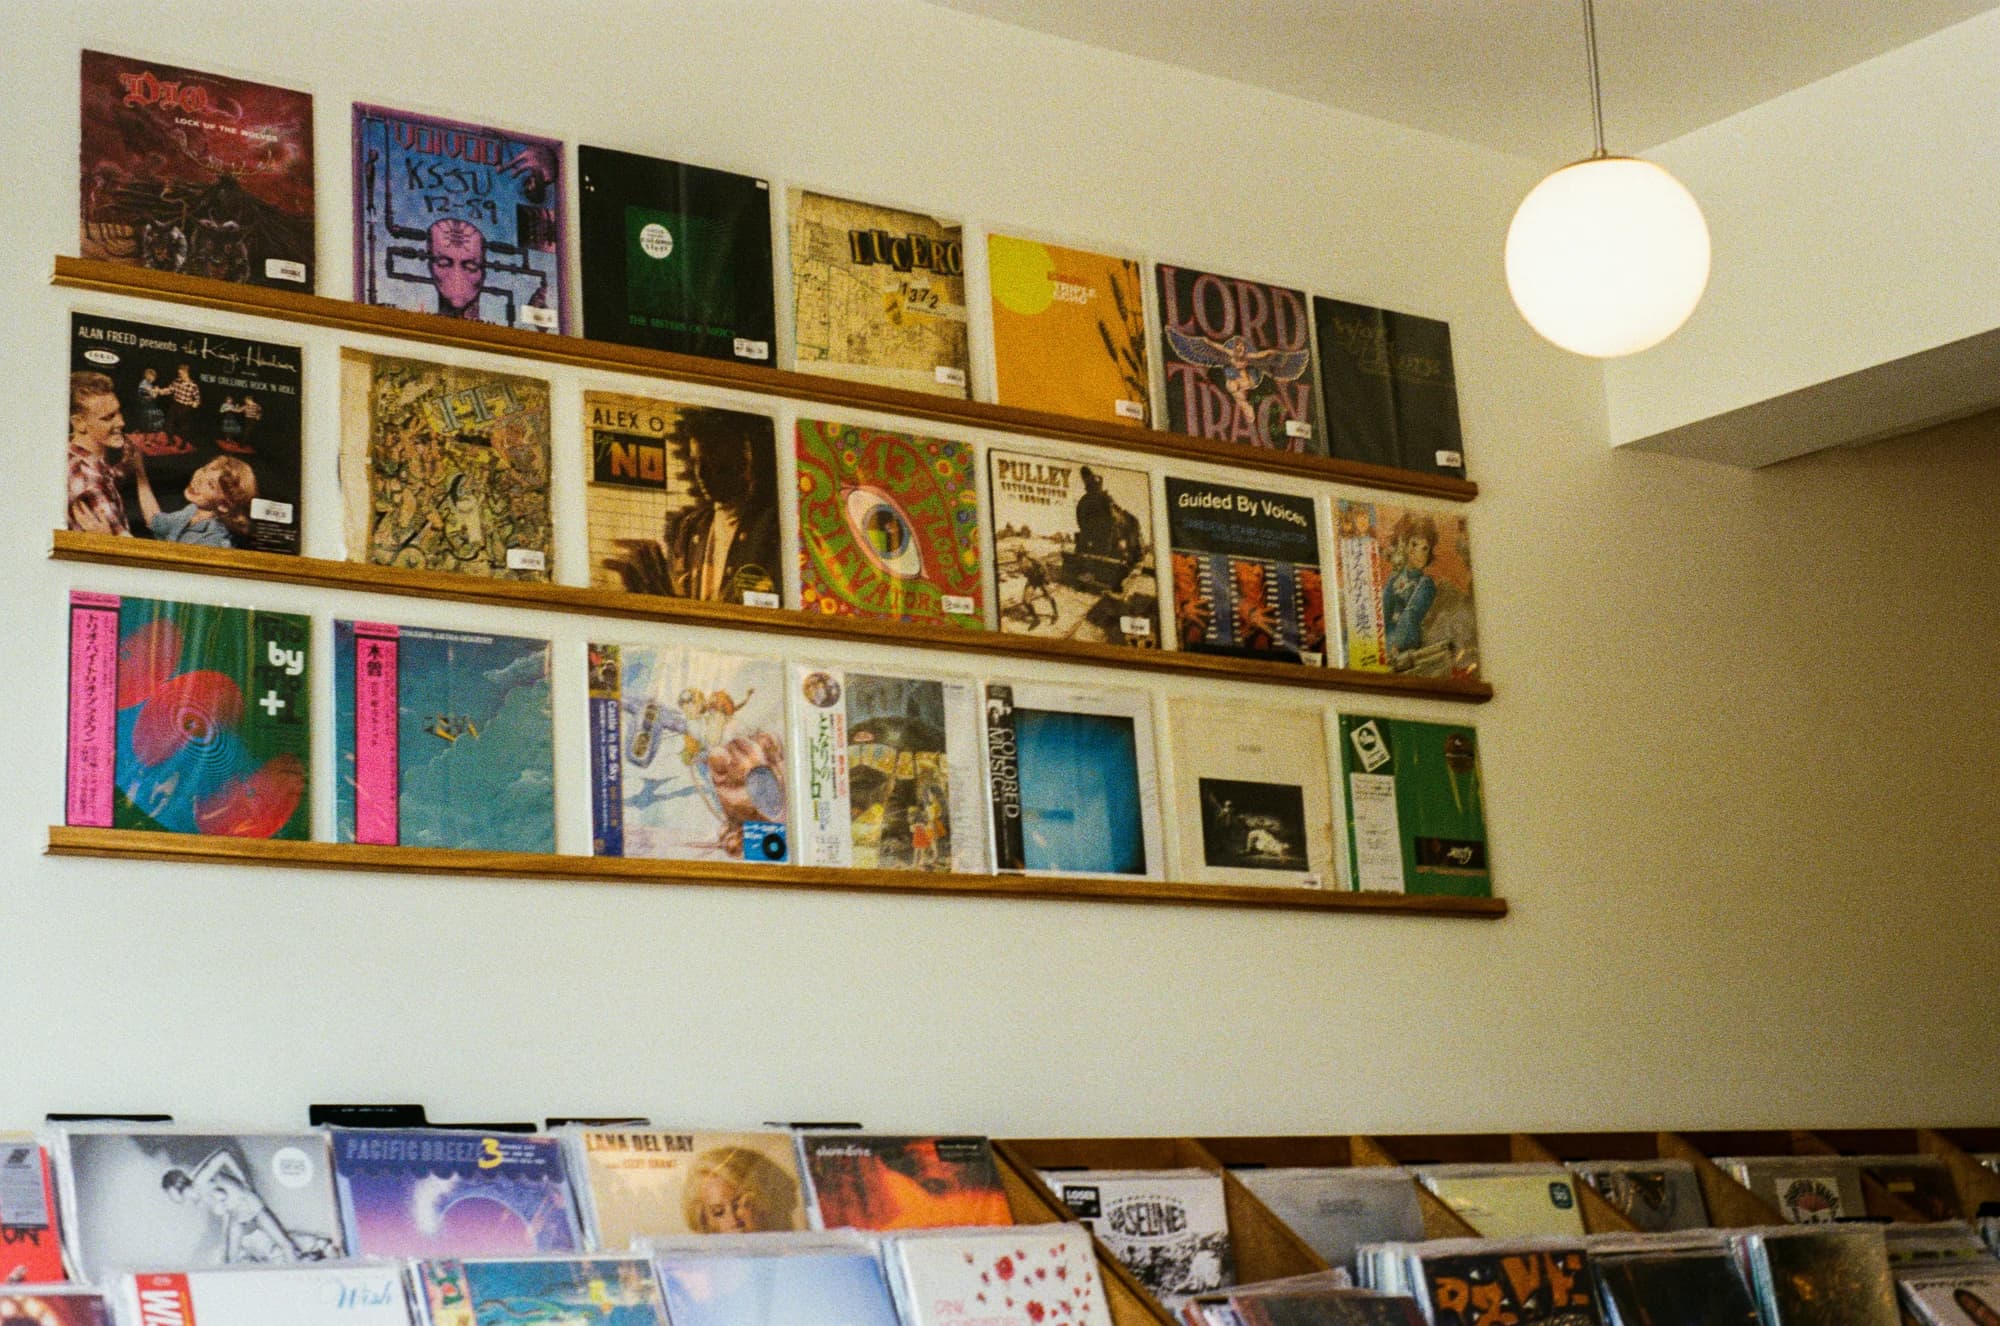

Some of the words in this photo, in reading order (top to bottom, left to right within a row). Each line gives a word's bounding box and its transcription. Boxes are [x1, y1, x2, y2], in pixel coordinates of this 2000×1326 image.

[119, 71, 208, 113] DIO
[175, 117, 200, 128] LOCK
[203, 121, 216, 130] UP
[219, 124, 237, 135] THE
[902, 282, 938, 309] 1372
[1161, 266, 1307, 351] LORD
[78, 326, 104, 340] ALAN
[106, 330, 137, 345] FREED
[139, 338, 178, 353] presents
[593, 408, 639, 430] ALEX
[997, 459, 1072, 488] PULLEY
[1178, 491, 1233, 511] Guided
[1237, 495, 1259, 517] By
[1261, 499, 1308, 527] Voices
[267, 640, 304, 676] by
[607, 762, 618, 781] Sky
[989, 727, 1005, 790] MUSIC
[1001, 727, 1020, 818] COLORED
[476, 1138, 502, 1168] 3
[585, 1133, 626, 1152] LANA
[631, 1134, 661, 1152] DEL
[662, 1135, 694, 1153] RAY
